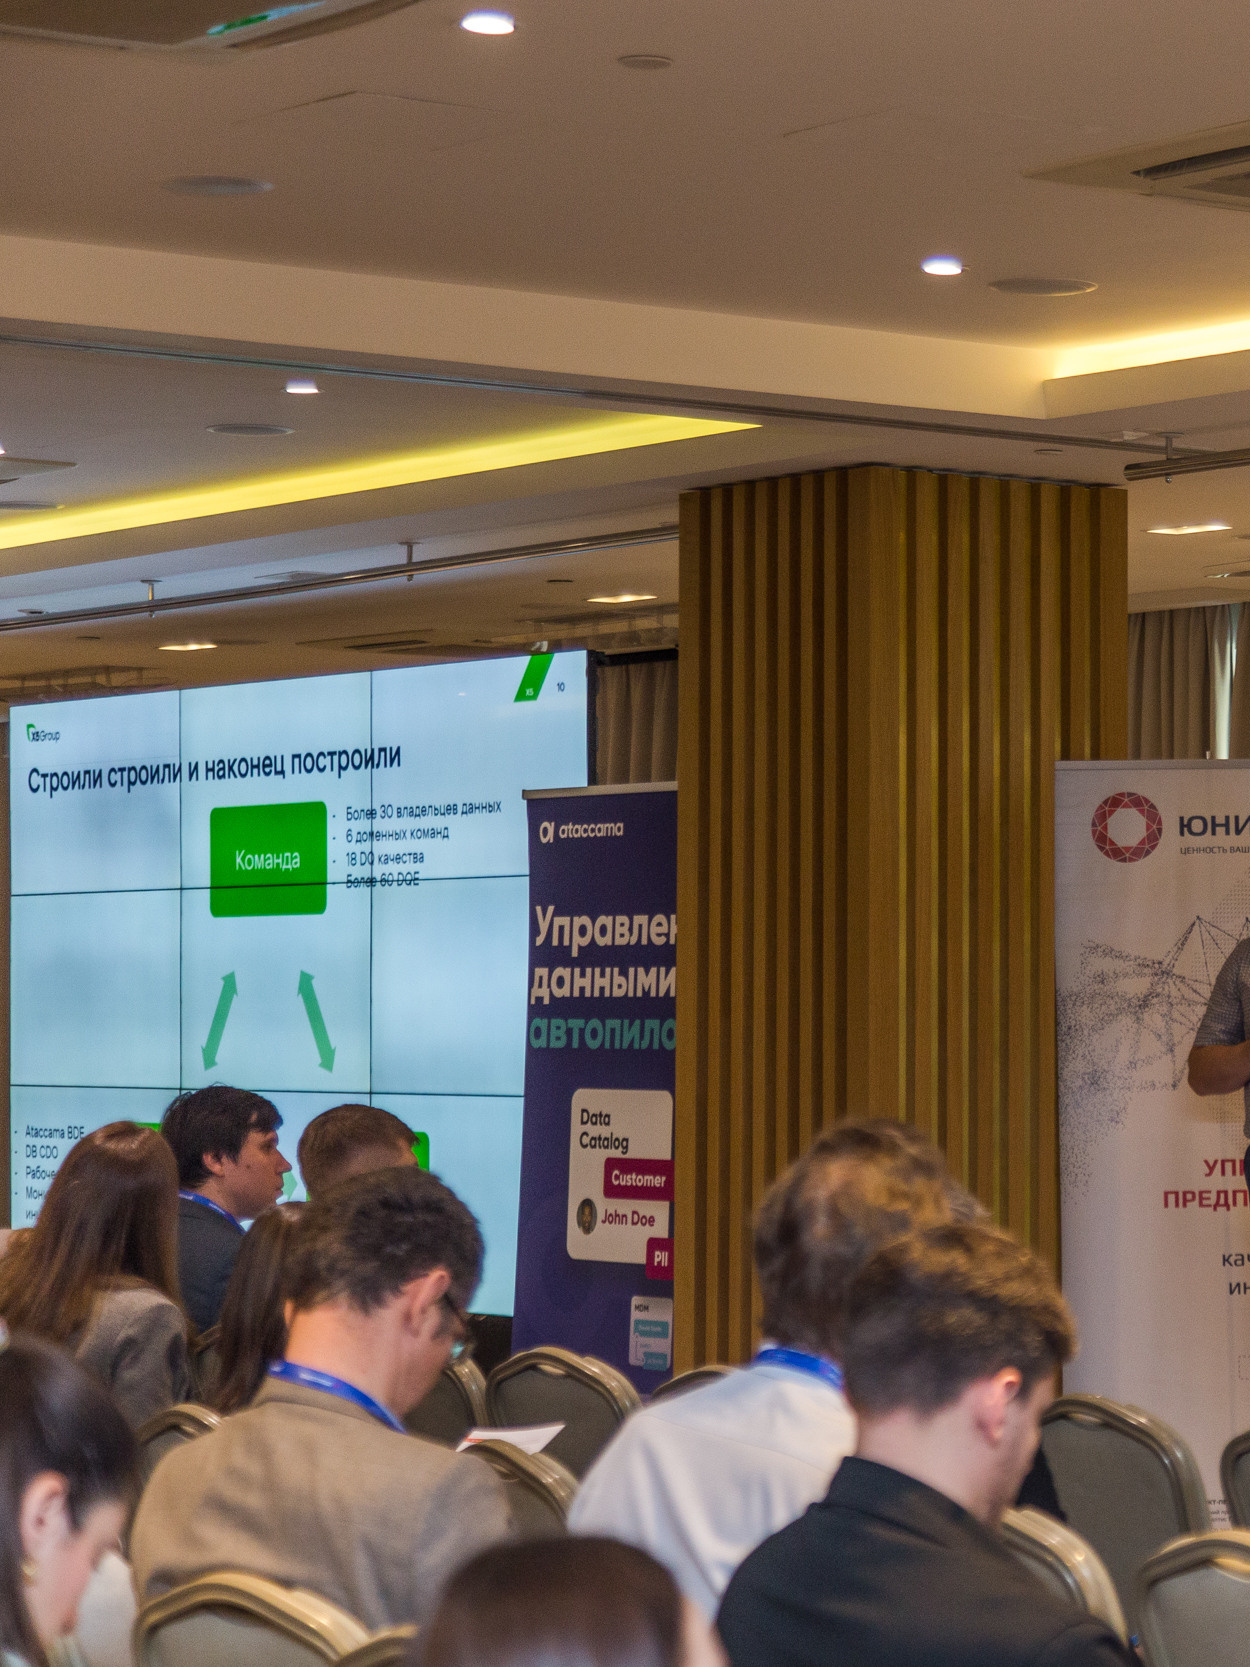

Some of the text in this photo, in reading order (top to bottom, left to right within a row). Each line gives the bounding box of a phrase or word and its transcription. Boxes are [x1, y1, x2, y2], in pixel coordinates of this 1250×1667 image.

[556, 681, 566, 693] 10
[28, 746, 401, 799] Строили строили и наконец построили
[345, 800, 502, 822] Более 30 владельцев данных
[345, 826, 450, 845] 6 доменных команд
[558, 821, 624, 839] ataccama
[345, 852, 357, 867] 18
[377, 851, 425, 866] качества
[1180, 845, 1228, 855] ЦЕННОСТЬ
[235, 849, 301, 872] Команда
[345, 871, 421, 889] Более 60 DQE
[530, 964, 677, 1005] данными
[580, 1108, 611, 1127] Data
[25, 1125, 65, 1139] Ataccama
[25, 1144, 59, 1159] DB CDO
[579, 1131, 630, 1155] Catalog
[611, 1170, 666, 1188] Customer
[1163, 1188, 1249, 1212] ПРЕДП
[601, 1208, 656, 1228] John Doe
[653, 1250, 669, 1267] PII
